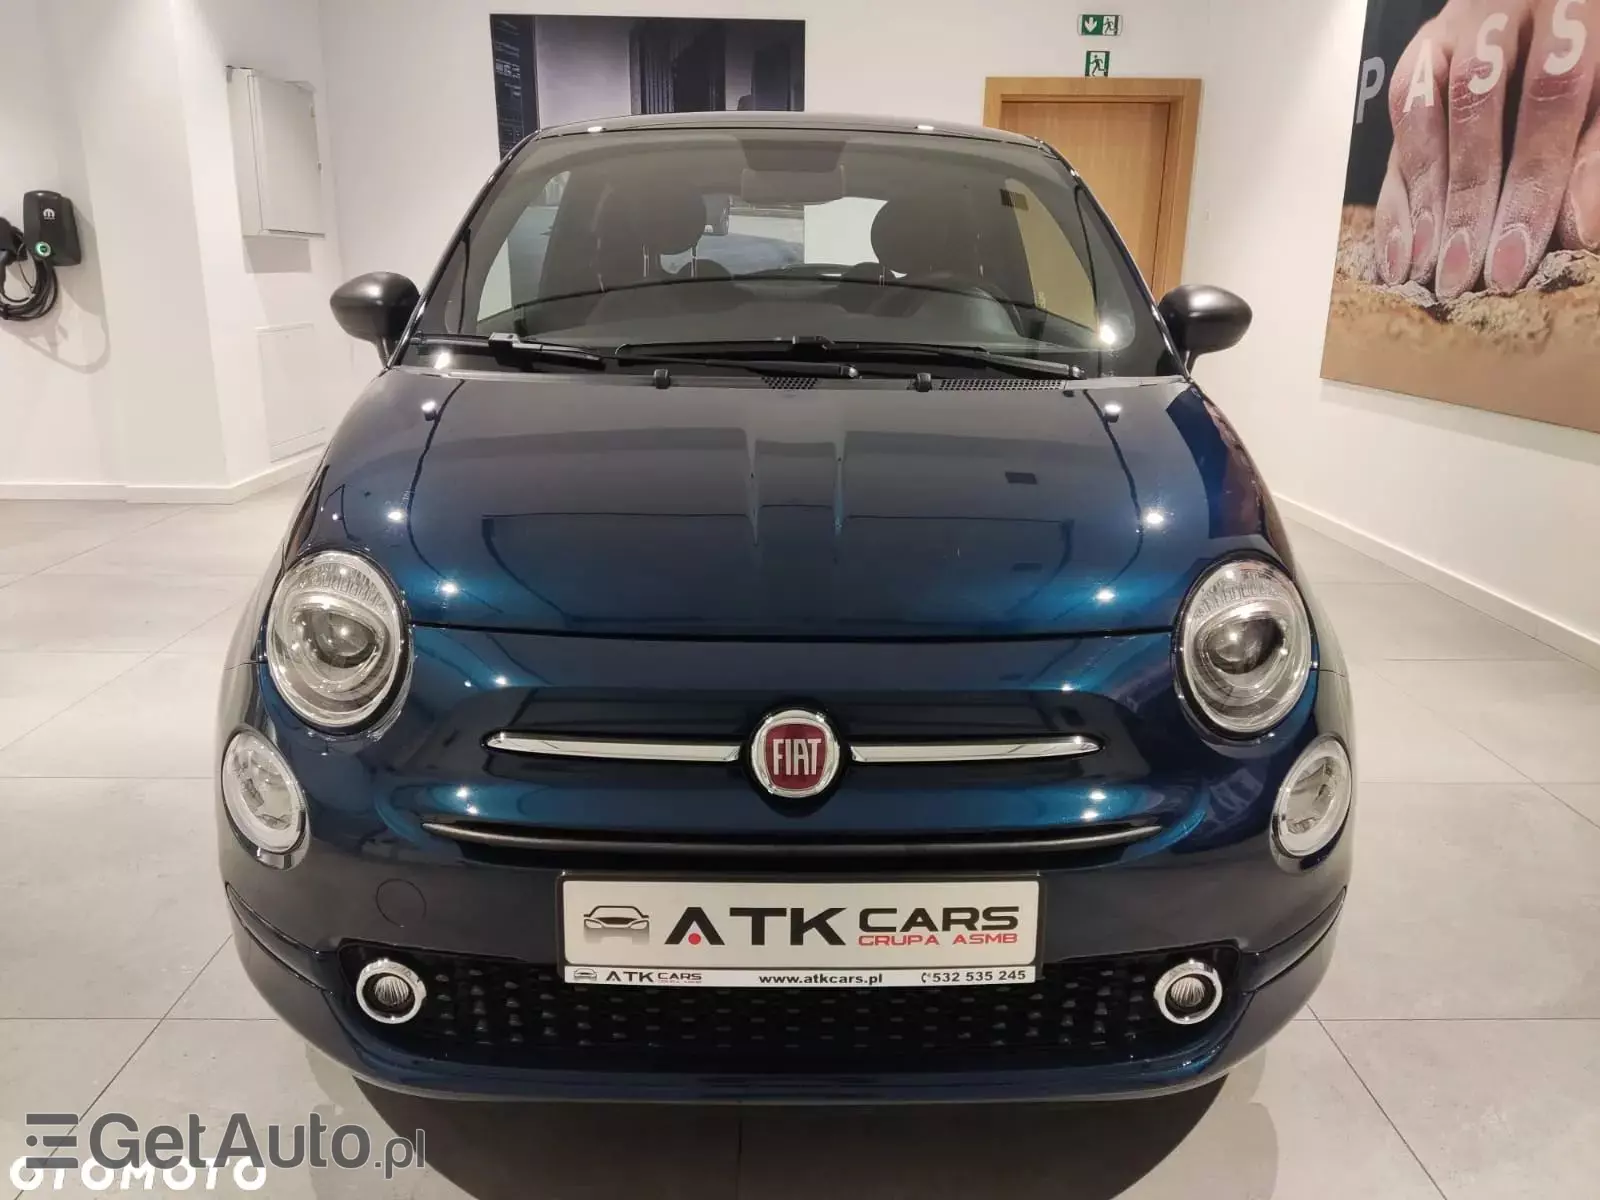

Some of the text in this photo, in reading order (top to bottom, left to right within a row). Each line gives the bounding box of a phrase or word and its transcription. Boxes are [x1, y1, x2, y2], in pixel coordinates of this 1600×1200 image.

[772, 738, 822, 776] FIAT
[663, 906, 1020, 946] ATK CARS
[858, 933, 1018, 946] GRUPA ASMB
[605, 970, 702, 983] ATK CARS
[758, 973, 883, 986] www.atkcars.pl
[932, 970, 1026, 983] 532 535 245
